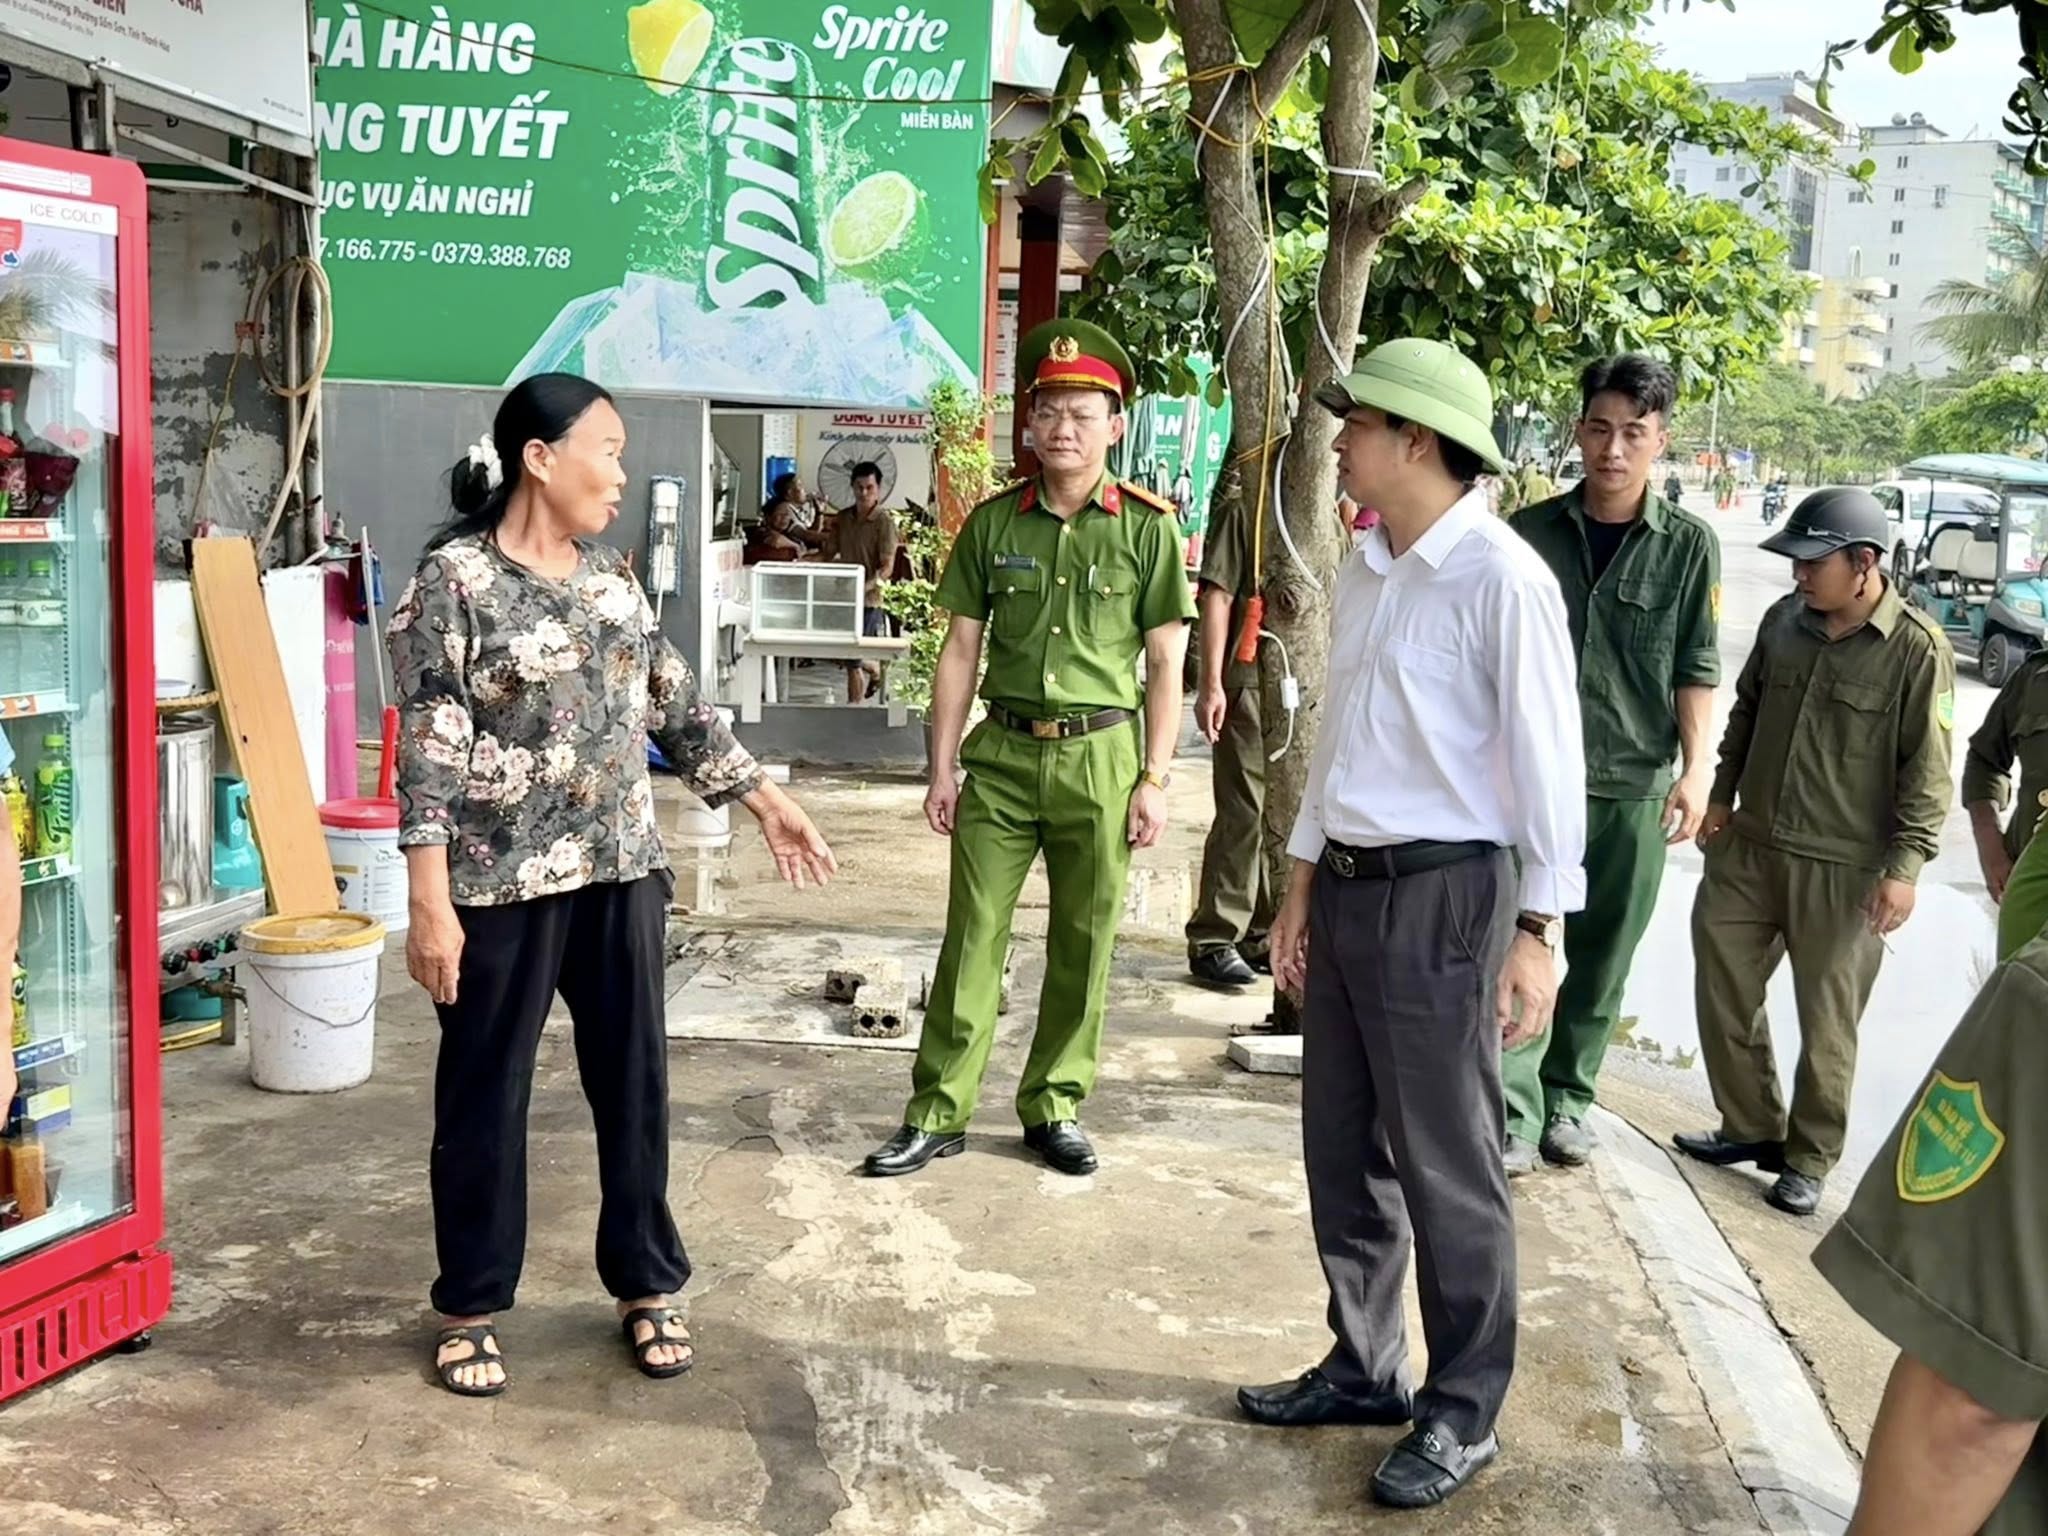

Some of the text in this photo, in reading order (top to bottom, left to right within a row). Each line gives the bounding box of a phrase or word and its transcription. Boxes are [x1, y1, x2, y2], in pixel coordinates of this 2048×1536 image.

[377, 5, 536, 75] HÀNG
[812, 5, 949, 60] Sprite
[862, 56, 967, 102] Cool
[397, 89, 570, 159] TUYẾT
[901, 105, 974, 130] MIỄN BÀN
[362, 182, 404, 217] VỤ
[405, 176, 451, 213] ĂN
[455, 179, 535, 217] NGHỈ
[706, 39, 819, 309] Sprite
[29, 203, 103, 225] ICE COLD
[431, 241, 572, 269] 0379.388.768
